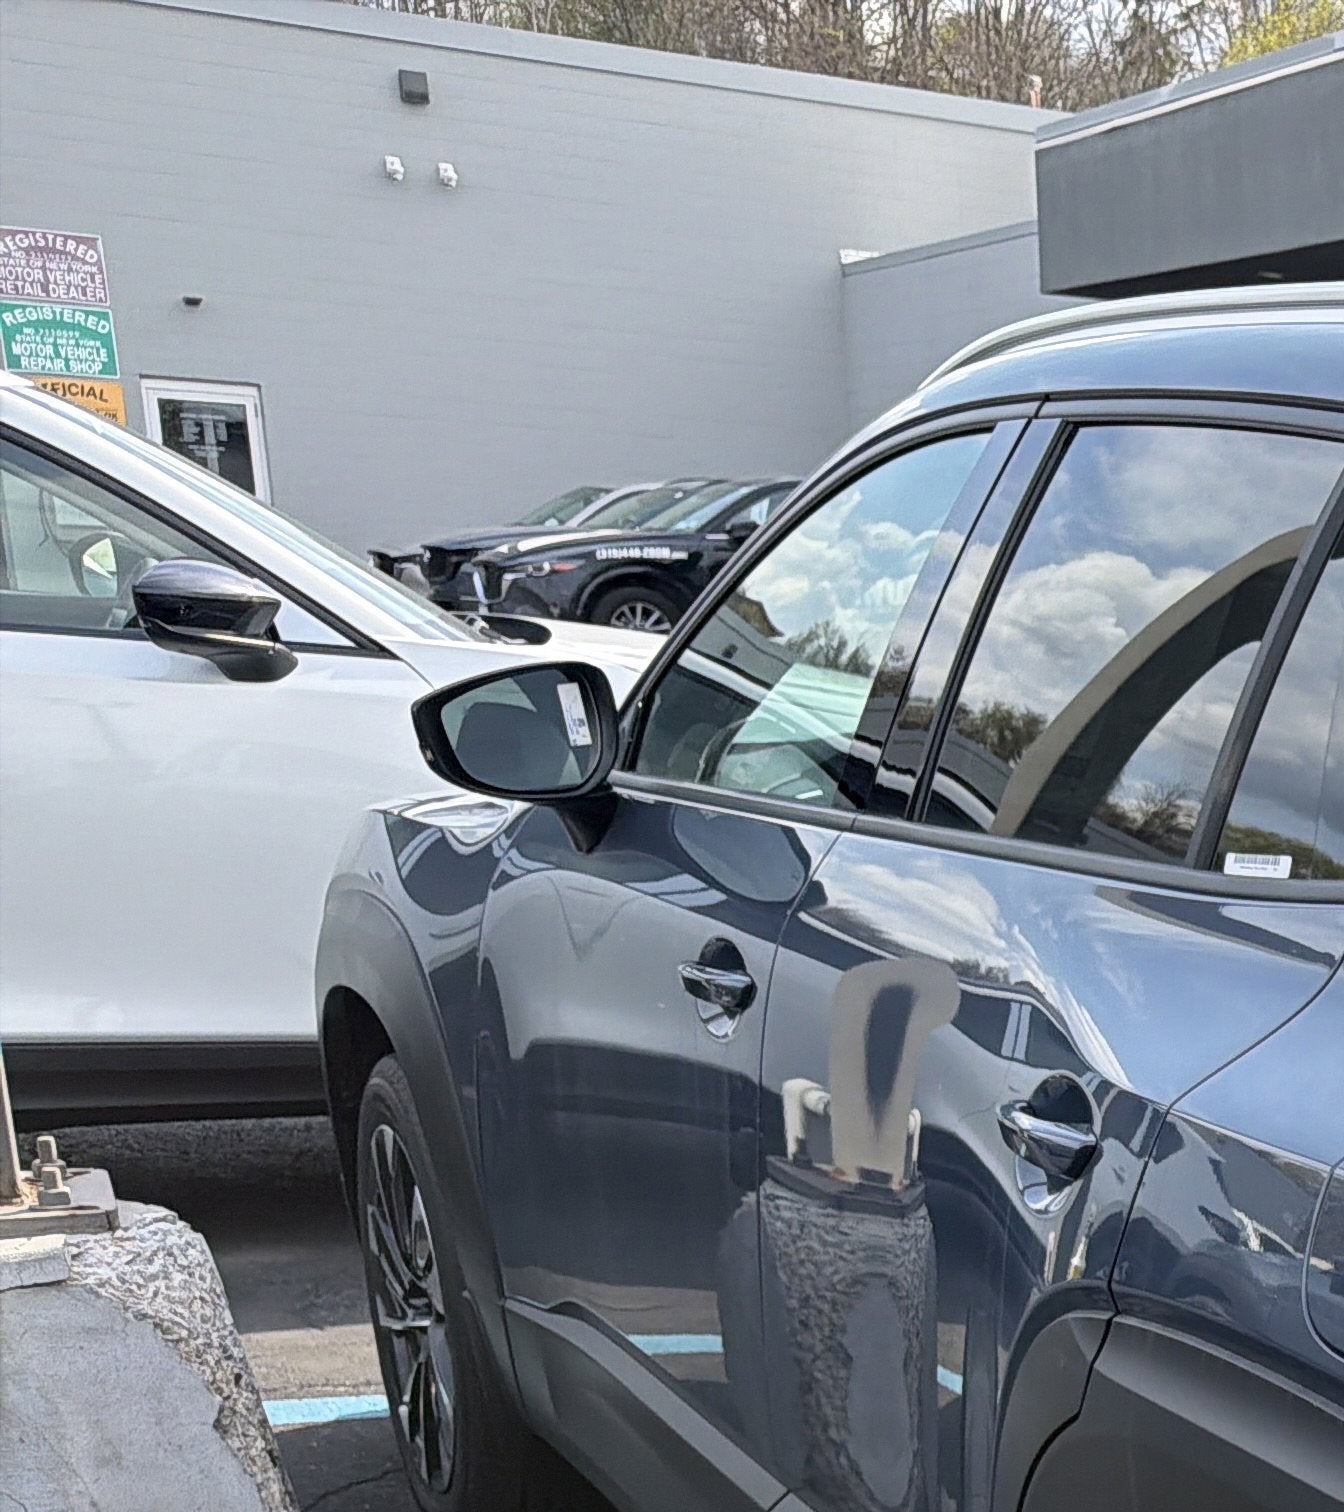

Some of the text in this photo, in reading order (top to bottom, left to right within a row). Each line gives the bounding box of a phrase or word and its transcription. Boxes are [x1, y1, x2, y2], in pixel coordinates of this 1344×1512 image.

[46, 260, 68, 271] NEW
[70, 262, 99, 274] YORK
[46, 269, 104, 288] VEHICLE
[49, 283, 106, 302] DEALER
[2, 306, 110, 334] REGISTERED
[12, 340, 109, 362] MOTOR VEHICLE
[20, 355, 103, 375] REPAIR SHOP
